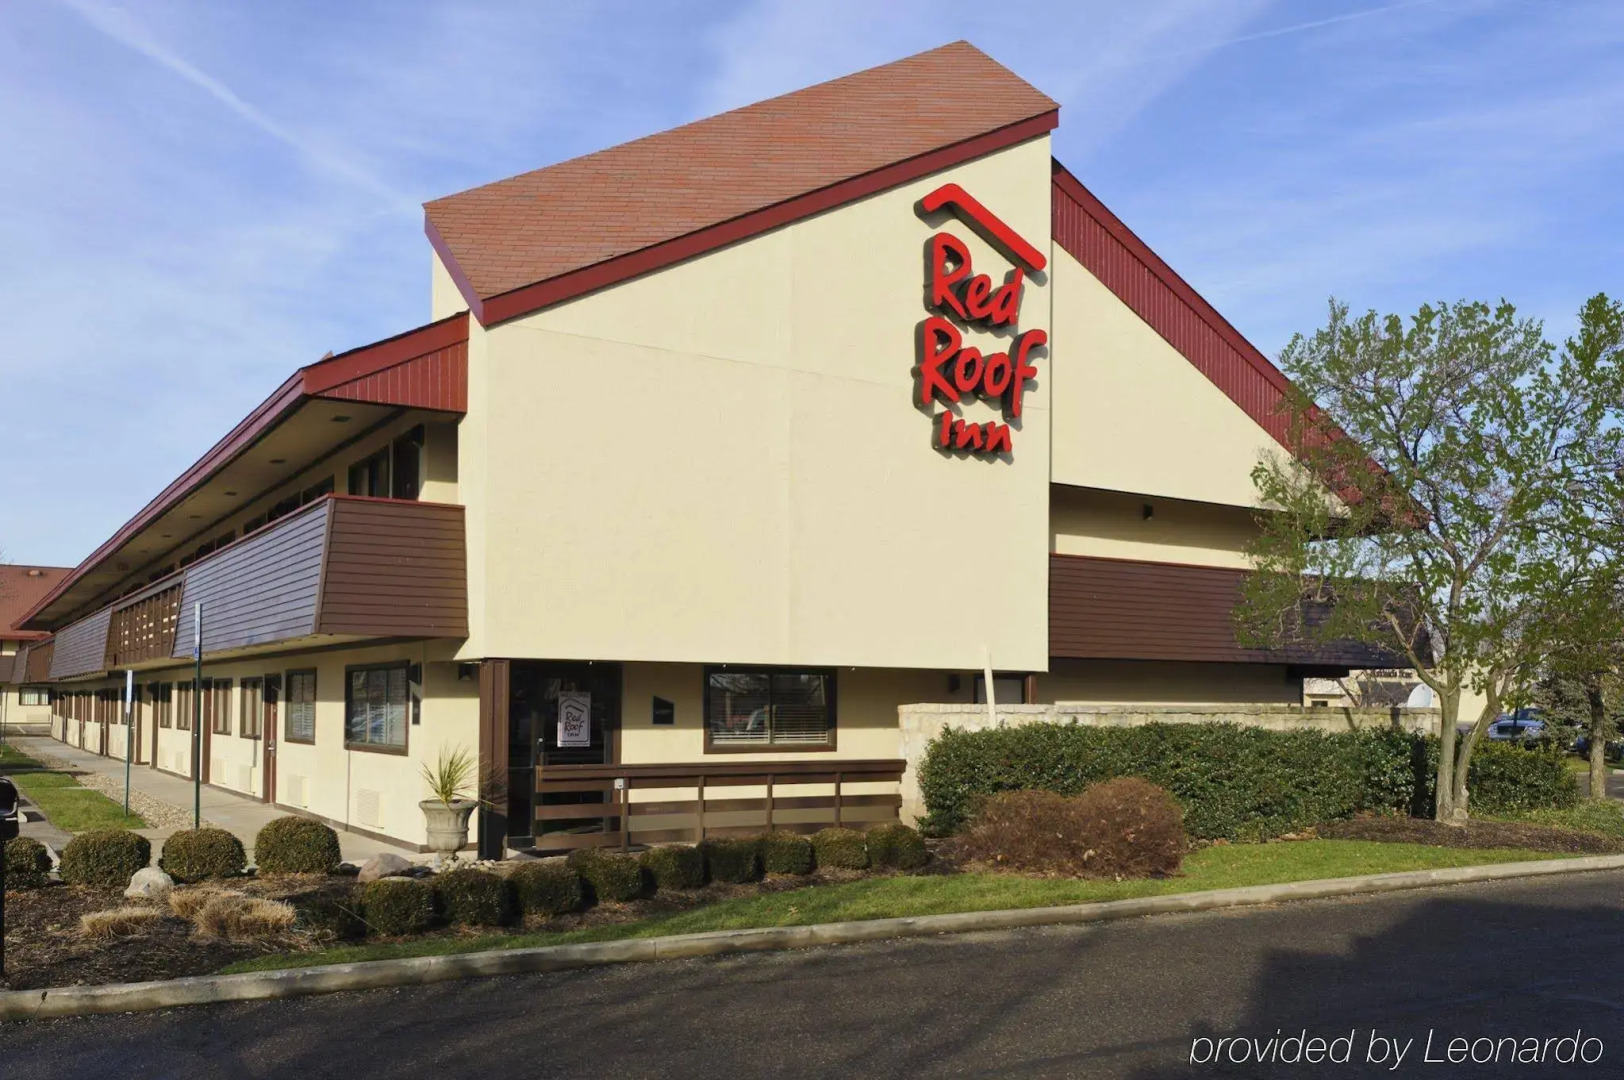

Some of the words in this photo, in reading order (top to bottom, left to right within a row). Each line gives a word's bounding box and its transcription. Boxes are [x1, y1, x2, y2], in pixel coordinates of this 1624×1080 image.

[933, 232, 1024, 326] Red
[920, 316, 1047, 418] Roof
[564, 720, 584, 733] Roof
[565, 711, 582, 722] Red
